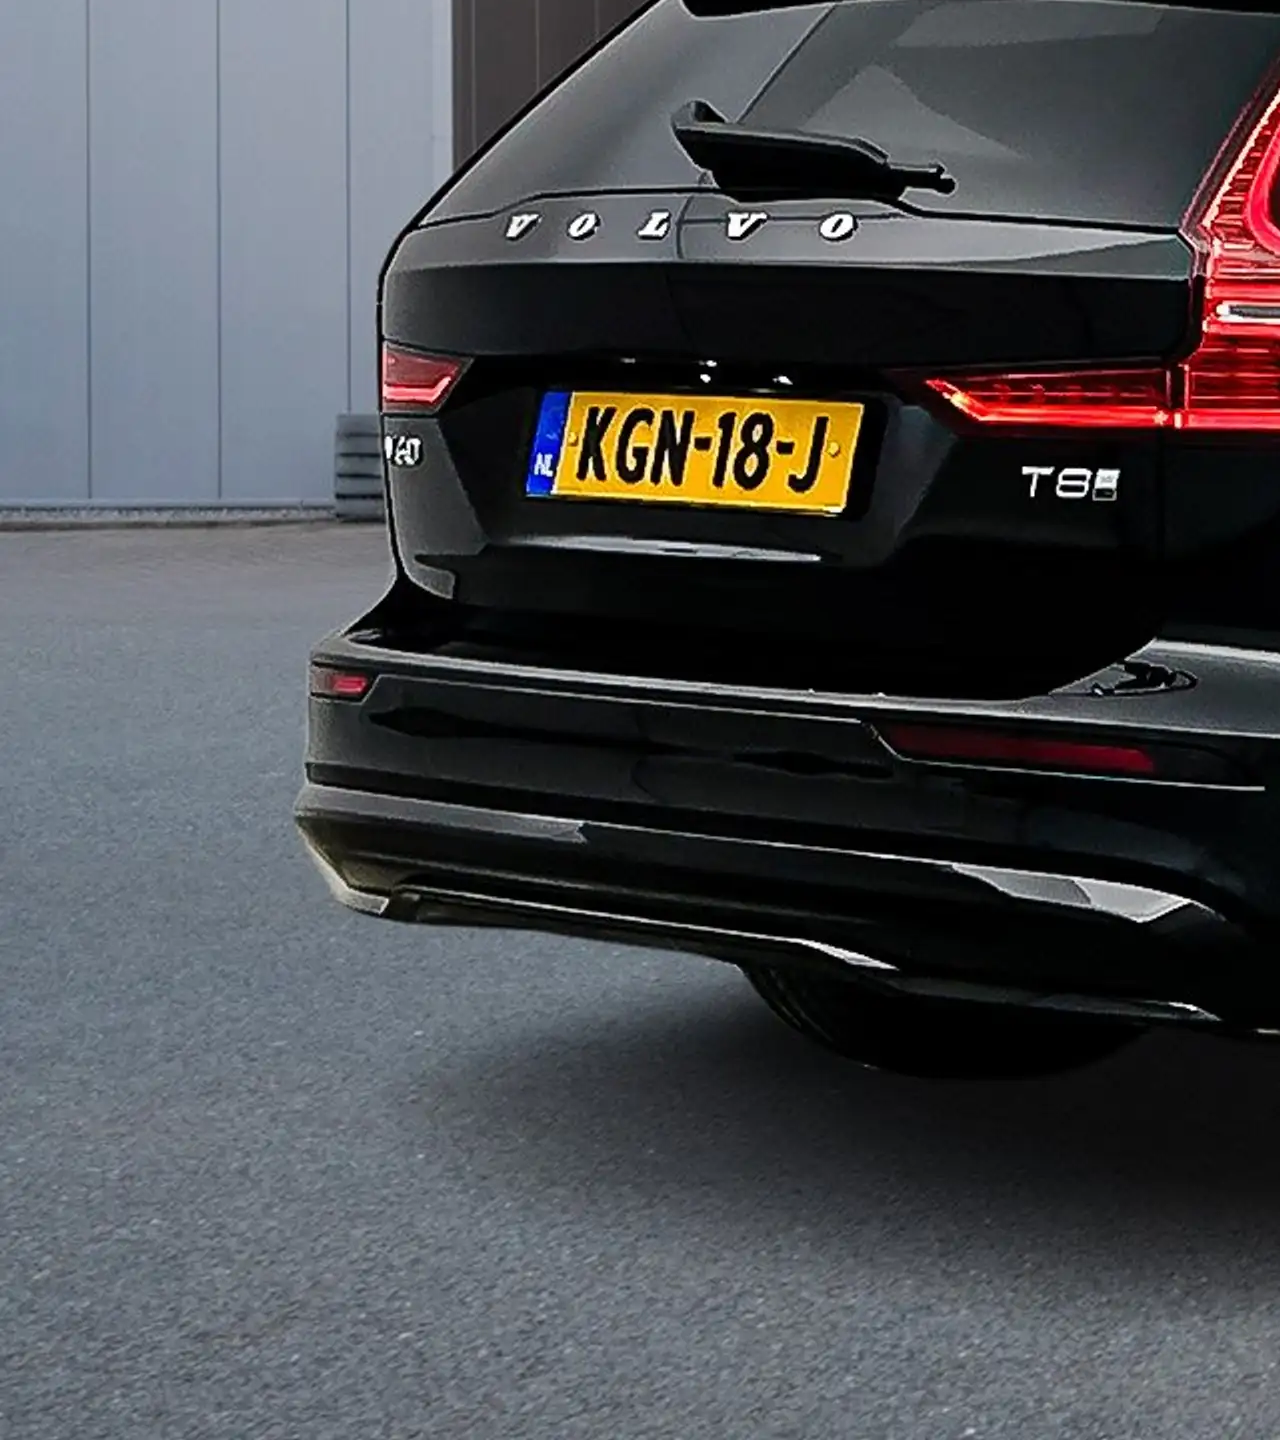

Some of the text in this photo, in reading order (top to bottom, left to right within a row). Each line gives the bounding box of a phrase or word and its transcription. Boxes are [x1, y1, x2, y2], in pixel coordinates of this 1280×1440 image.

[505, 212, 856, 239] VOLVO
[576, 405, 830, 493] KGN-18-J
[533, 451, 554, 477] NL
